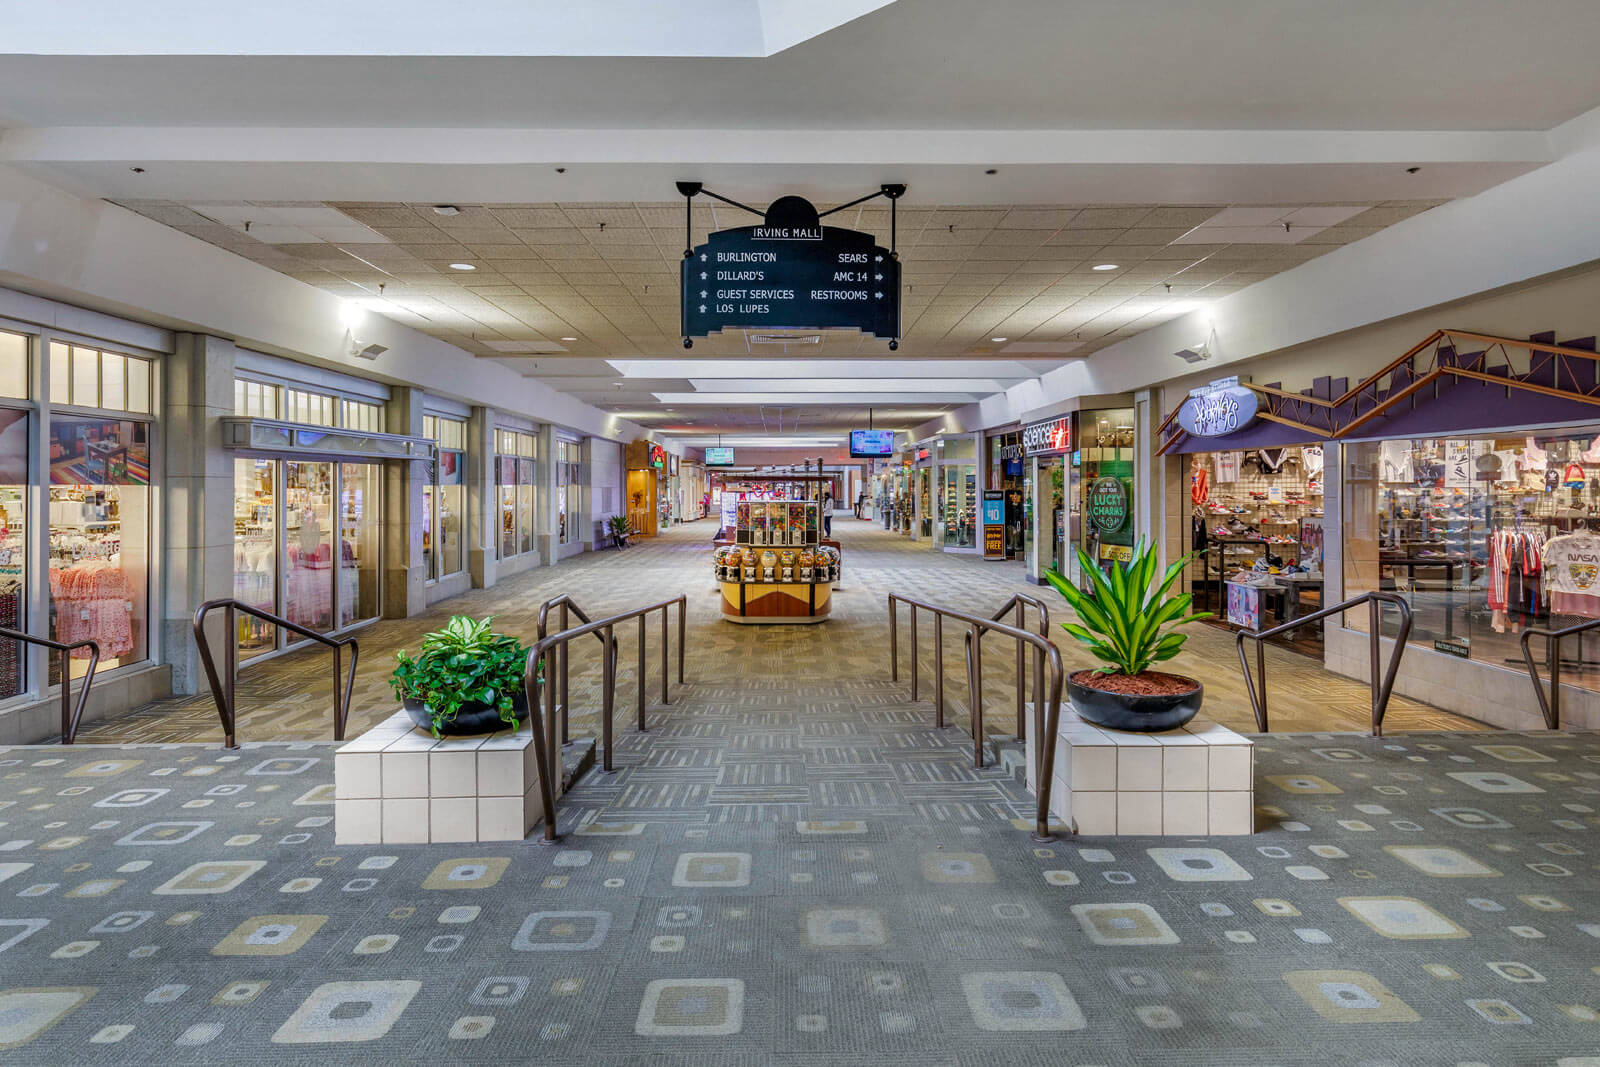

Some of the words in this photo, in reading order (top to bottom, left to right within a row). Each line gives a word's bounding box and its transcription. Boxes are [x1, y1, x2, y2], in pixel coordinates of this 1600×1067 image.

[753, 229, 789, 238] IRVING
[793, 229, 820, 238] MALL
[717, 252, 777, 262] BURLINGTON
[838, 254, 868, 263] SEARS
[717, 271, 764, 281] DILLARD'S
[833, 272, 854, 282] AMC
[857, 272, 868, 282] 14
[717, 290, 748, 299] GUEST
[750, 290, 794, 299] SERVICES
[811, 290, 868, 300] RESTROOMS
[716, 304, 734, 313] LOS
[739, 304, 770, 313] LUPES
[1094, 494, 1121, 505] LUCKY
[1093, 506, 1123, 516] CHARMS
[986, 540, 1001, 549] FREE
[1568, 553, 1598, 562] NASA
